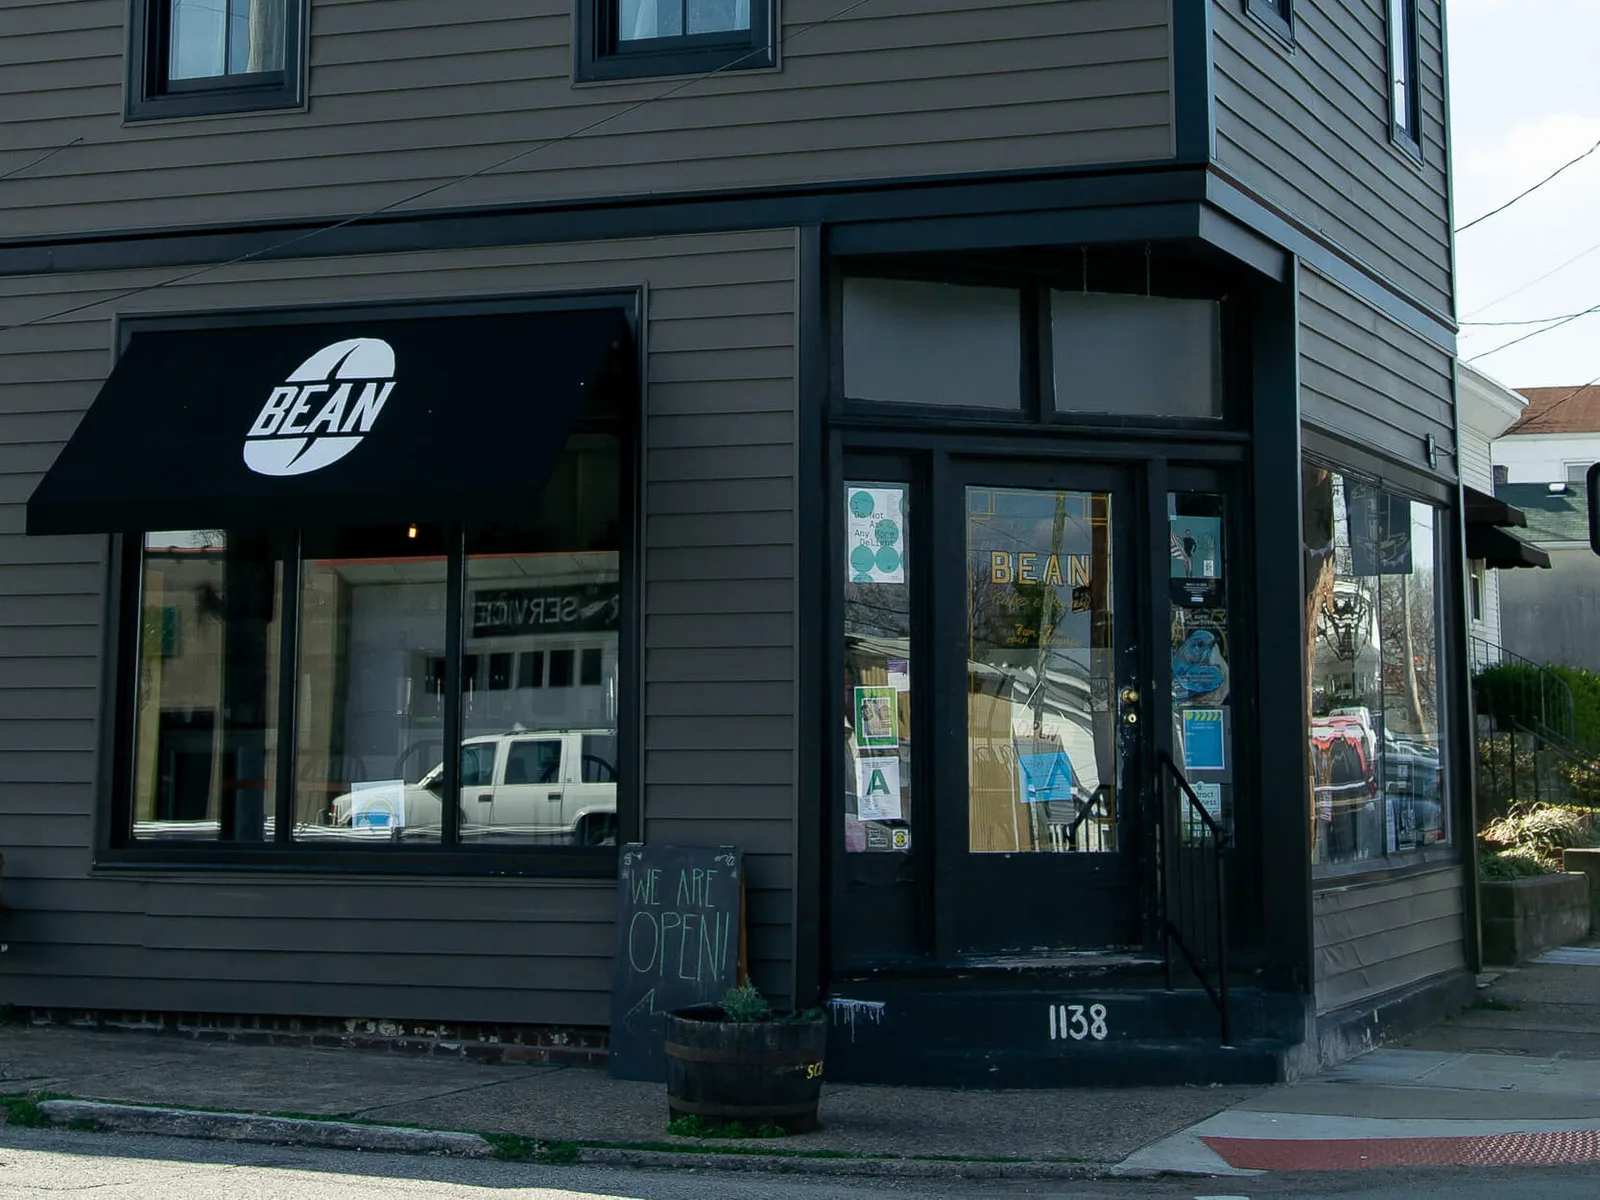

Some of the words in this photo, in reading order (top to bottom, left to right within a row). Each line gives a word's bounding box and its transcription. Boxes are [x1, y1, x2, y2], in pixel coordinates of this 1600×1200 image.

[246, 381, 397, 436] BEAN
[854, 529, 870, 538] Any
[860, 539, 893, 548] Delight
[990, 550, 1090, 587] BEAN
[867, 769, 891, 795] A
[631, 868, 663, 905] WE
[676, 868, 718, 907] ARE
[629, 911, 730, 981] OPEN!
[1049, 1003, 1108, 1040] 1138
